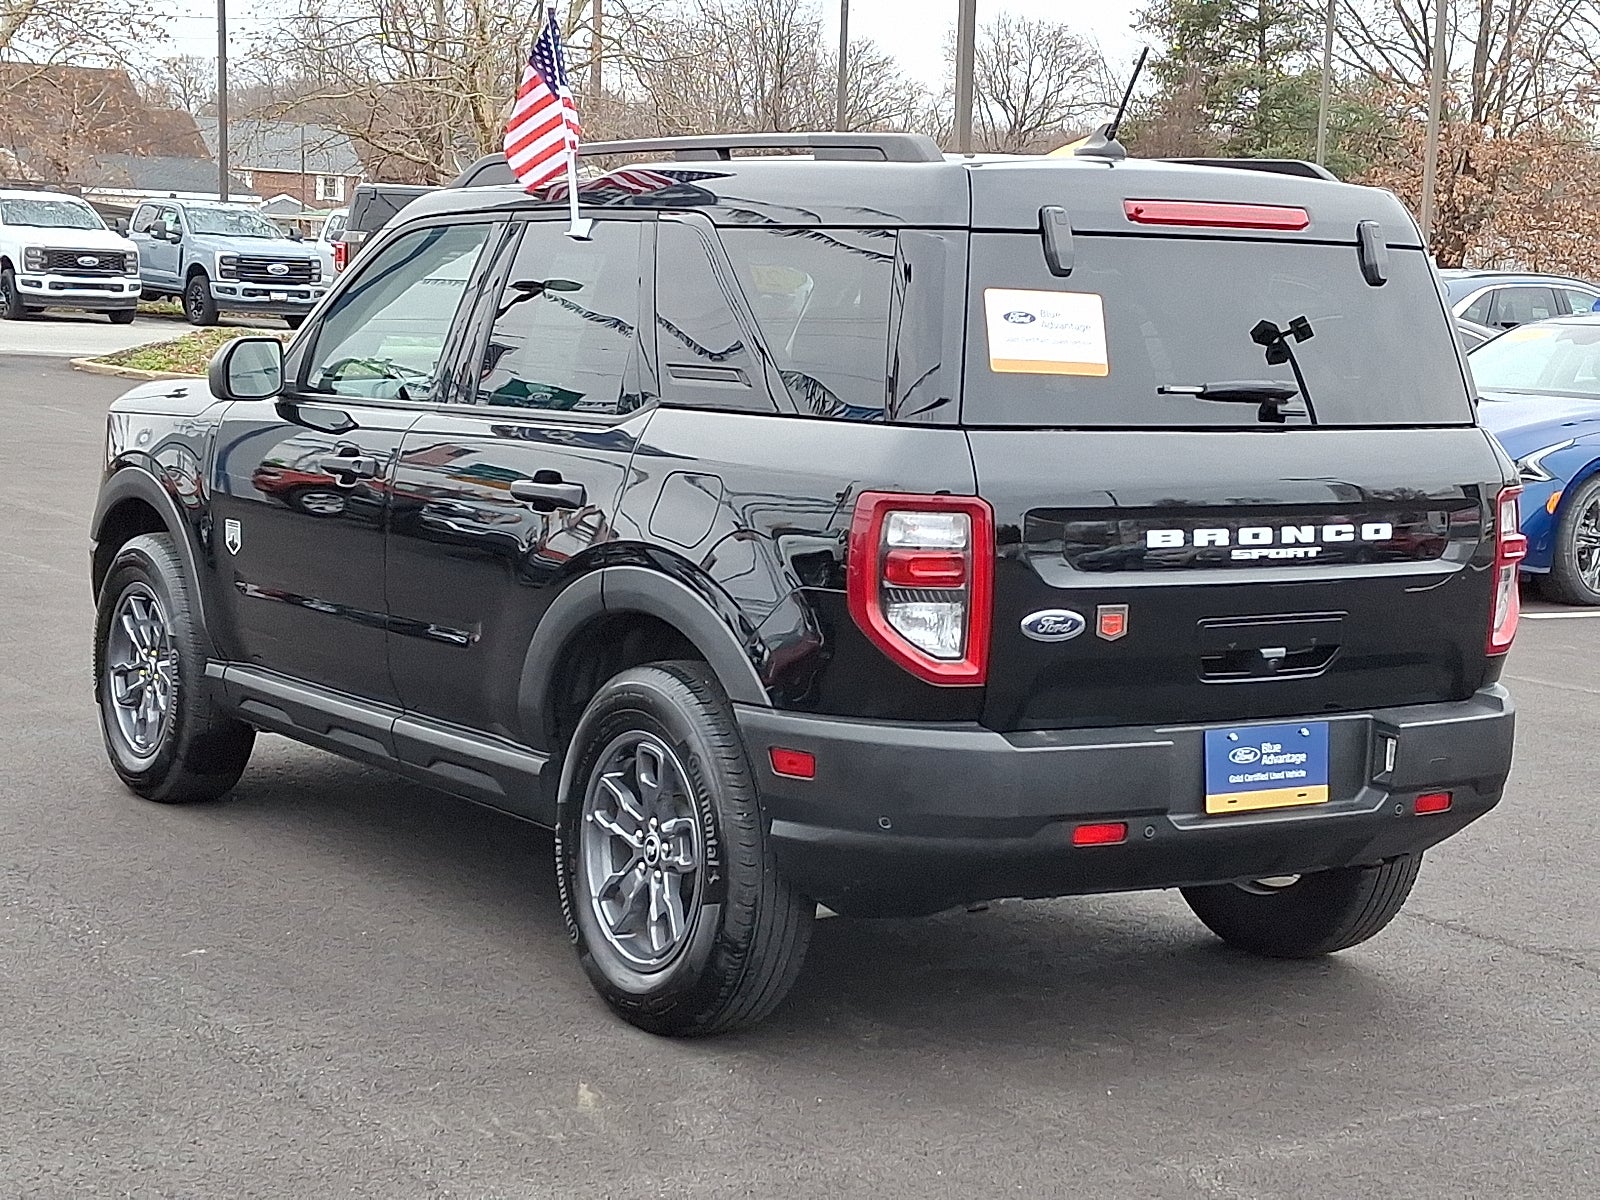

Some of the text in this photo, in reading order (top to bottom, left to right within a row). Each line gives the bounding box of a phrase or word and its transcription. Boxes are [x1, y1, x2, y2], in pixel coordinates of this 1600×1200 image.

[1040, 309, 1061, 318] Blue
[1041, 320, 1091, 332] Advantage
[1146, 523, 1392, 548] BRONCO
[1231, 547, 1322, 560] SPORT
[1037, 616, 1072, 633] Ford
[1261, 742, 1282, 754] Blue
[1261, 753, 1307, 765] Advantage
[1228, 769, 1307, 784] Gold Certified Used Vehicle
